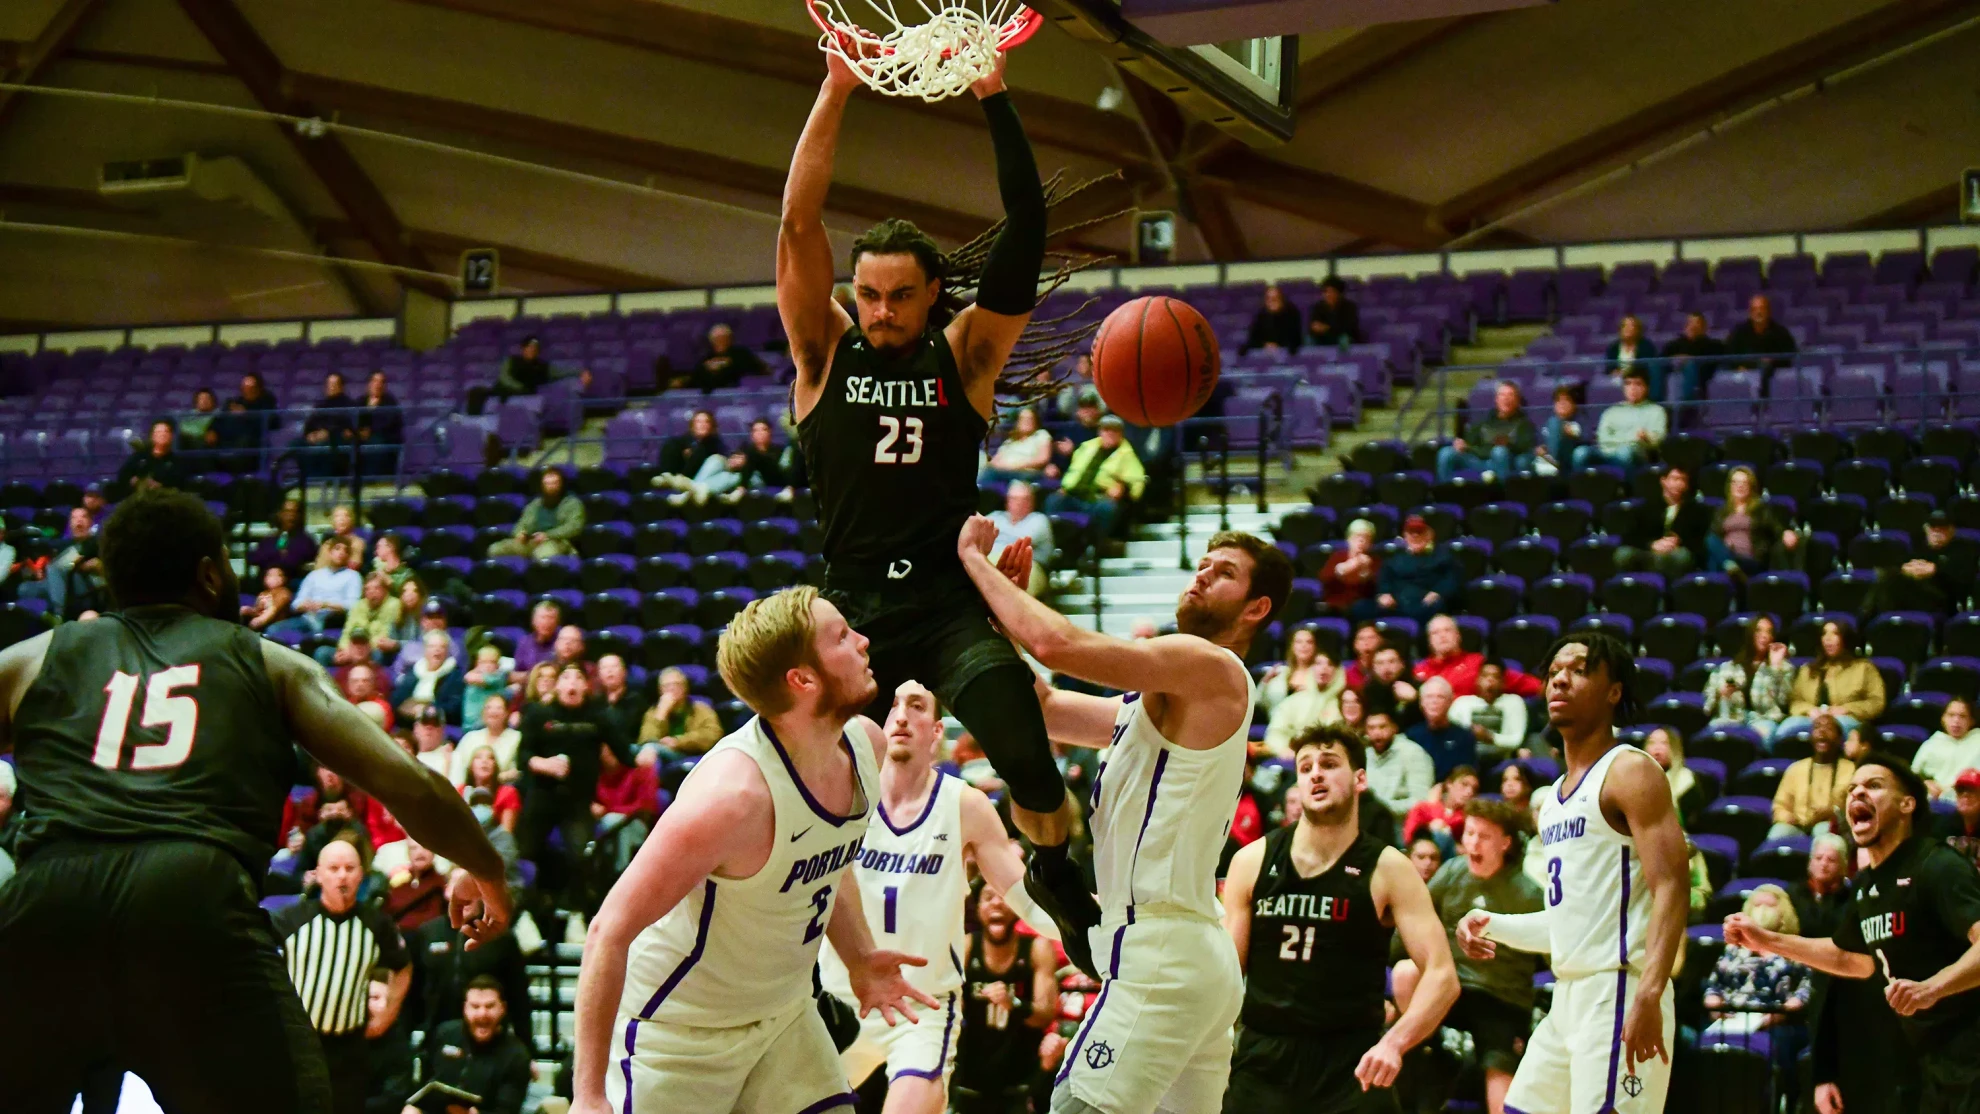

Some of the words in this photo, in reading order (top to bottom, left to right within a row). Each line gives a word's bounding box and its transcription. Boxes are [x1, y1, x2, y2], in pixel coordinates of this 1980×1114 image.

[1142, 220, 1172, 248] 13
[468, 258, 492, 282] 12
[874, 415, 924, 464] 23
[90, 662, 201, 770] 15
[1547, 855, 1563, 907] 3
[801, 884, 833, 946] 2
[883, 885, 899, 934] 1
[1255, 893, 1351, 921] SEATTLEU
[1279, 924, 1316, 962] 21
